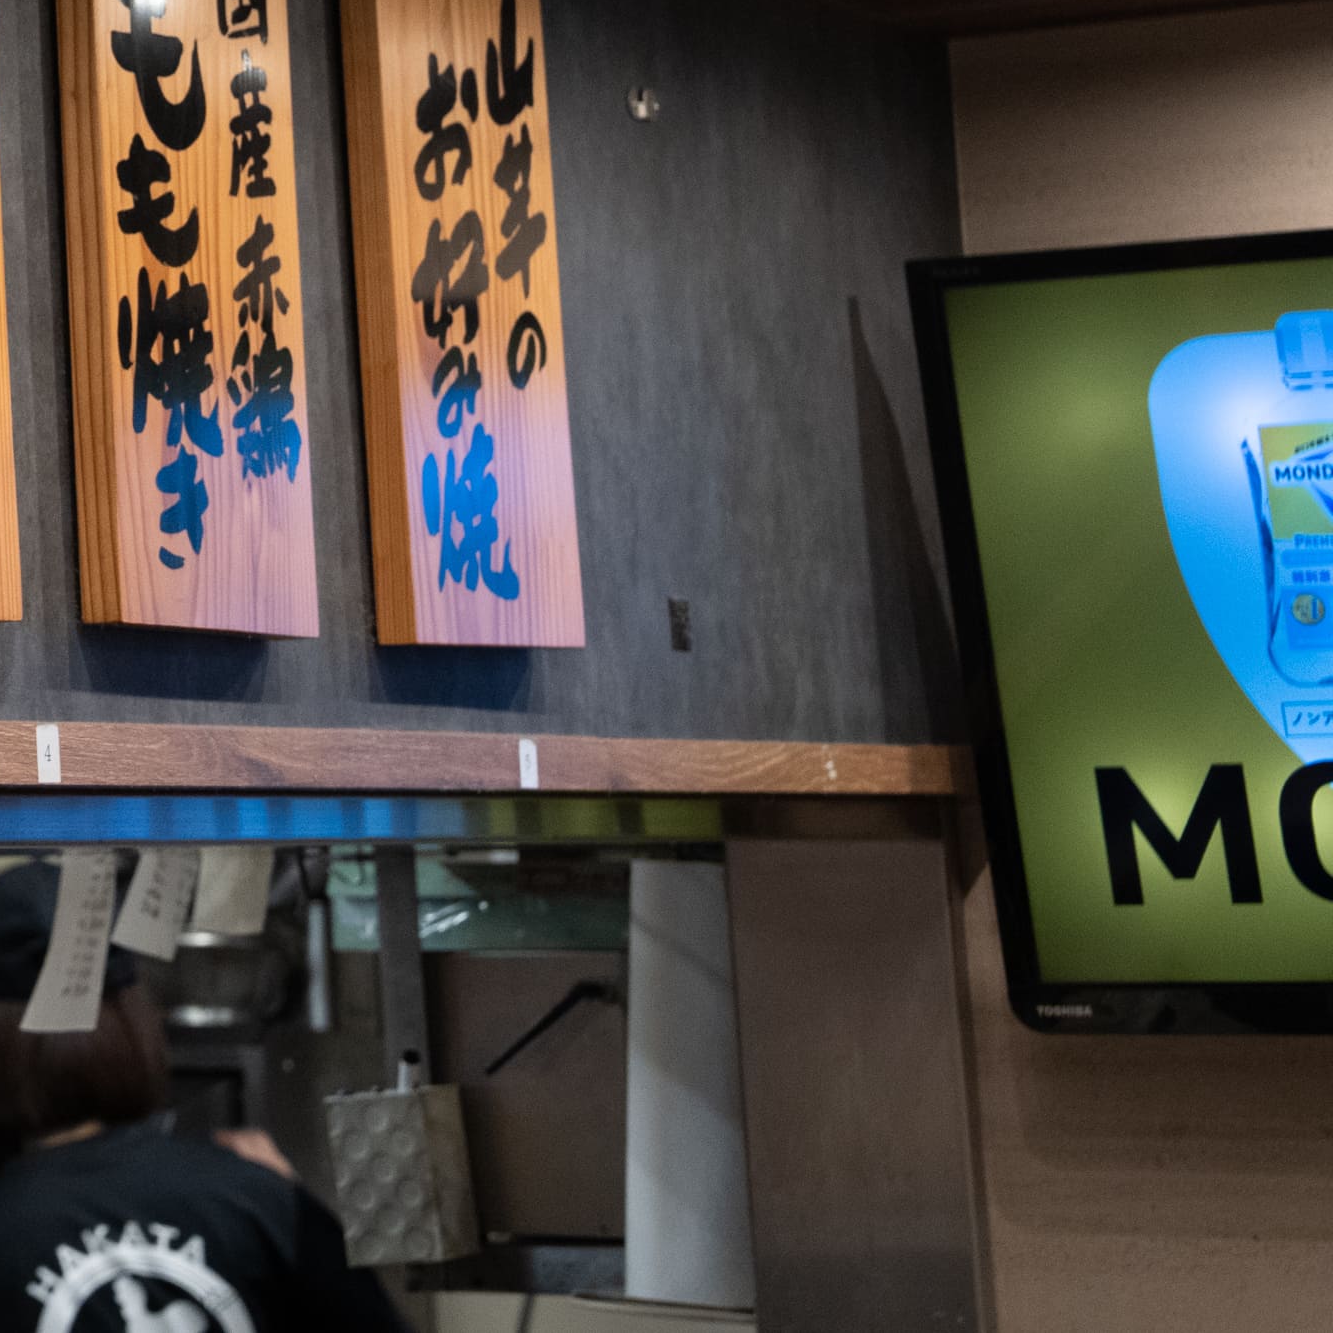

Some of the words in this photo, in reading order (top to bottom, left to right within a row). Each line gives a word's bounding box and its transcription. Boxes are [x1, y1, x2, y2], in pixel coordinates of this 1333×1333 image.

[411, 51, 520, 602] お好み焼
[45, 743, 53, 762] 4
[25, 1220, 206, 1304] HAKATA
